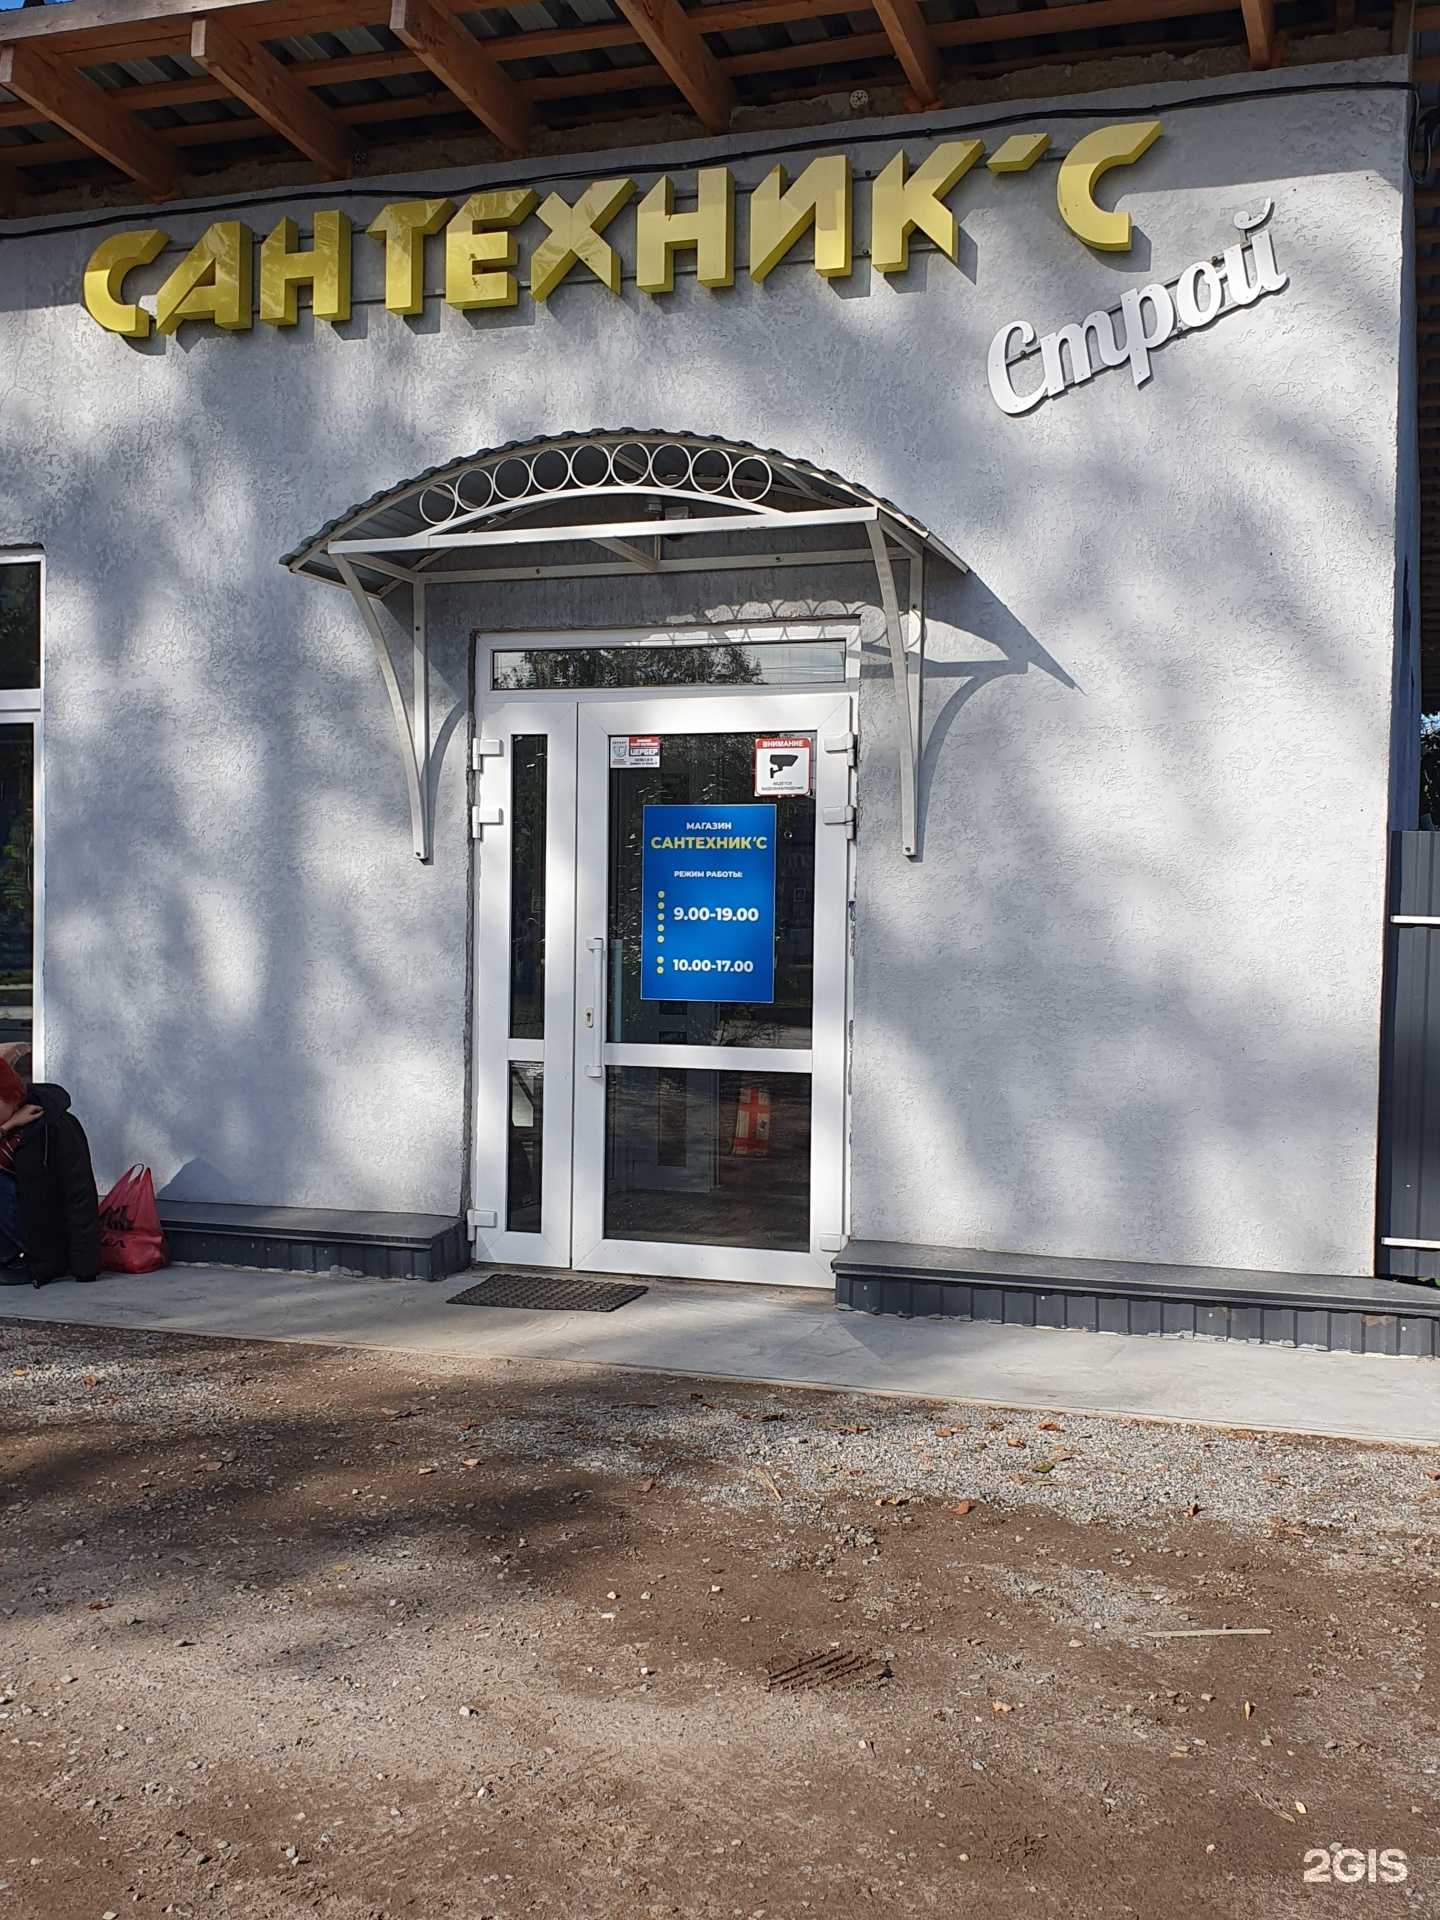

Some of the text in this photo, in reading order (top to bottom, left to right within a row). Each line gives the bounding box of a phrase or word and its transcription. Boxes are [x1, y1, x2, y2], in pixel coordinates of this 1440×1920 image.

[84, 122, 1160, 338] САНТЕХНИК'С
[986, 196, 1288, 416] Строй
[762, 739, 805, 748] ВНИМАНИЕ
[686, 822, 732, 830] МАГАЗИН
[650, 836, 768, 850] САНТЕХНИК'С
[673, 870, 744, 879] РЕЖИМ РАБОТЫ:
[673, 907, 760, 922] 9.00-19.00
[672, 959, 755, 973] 10.00-17.00
